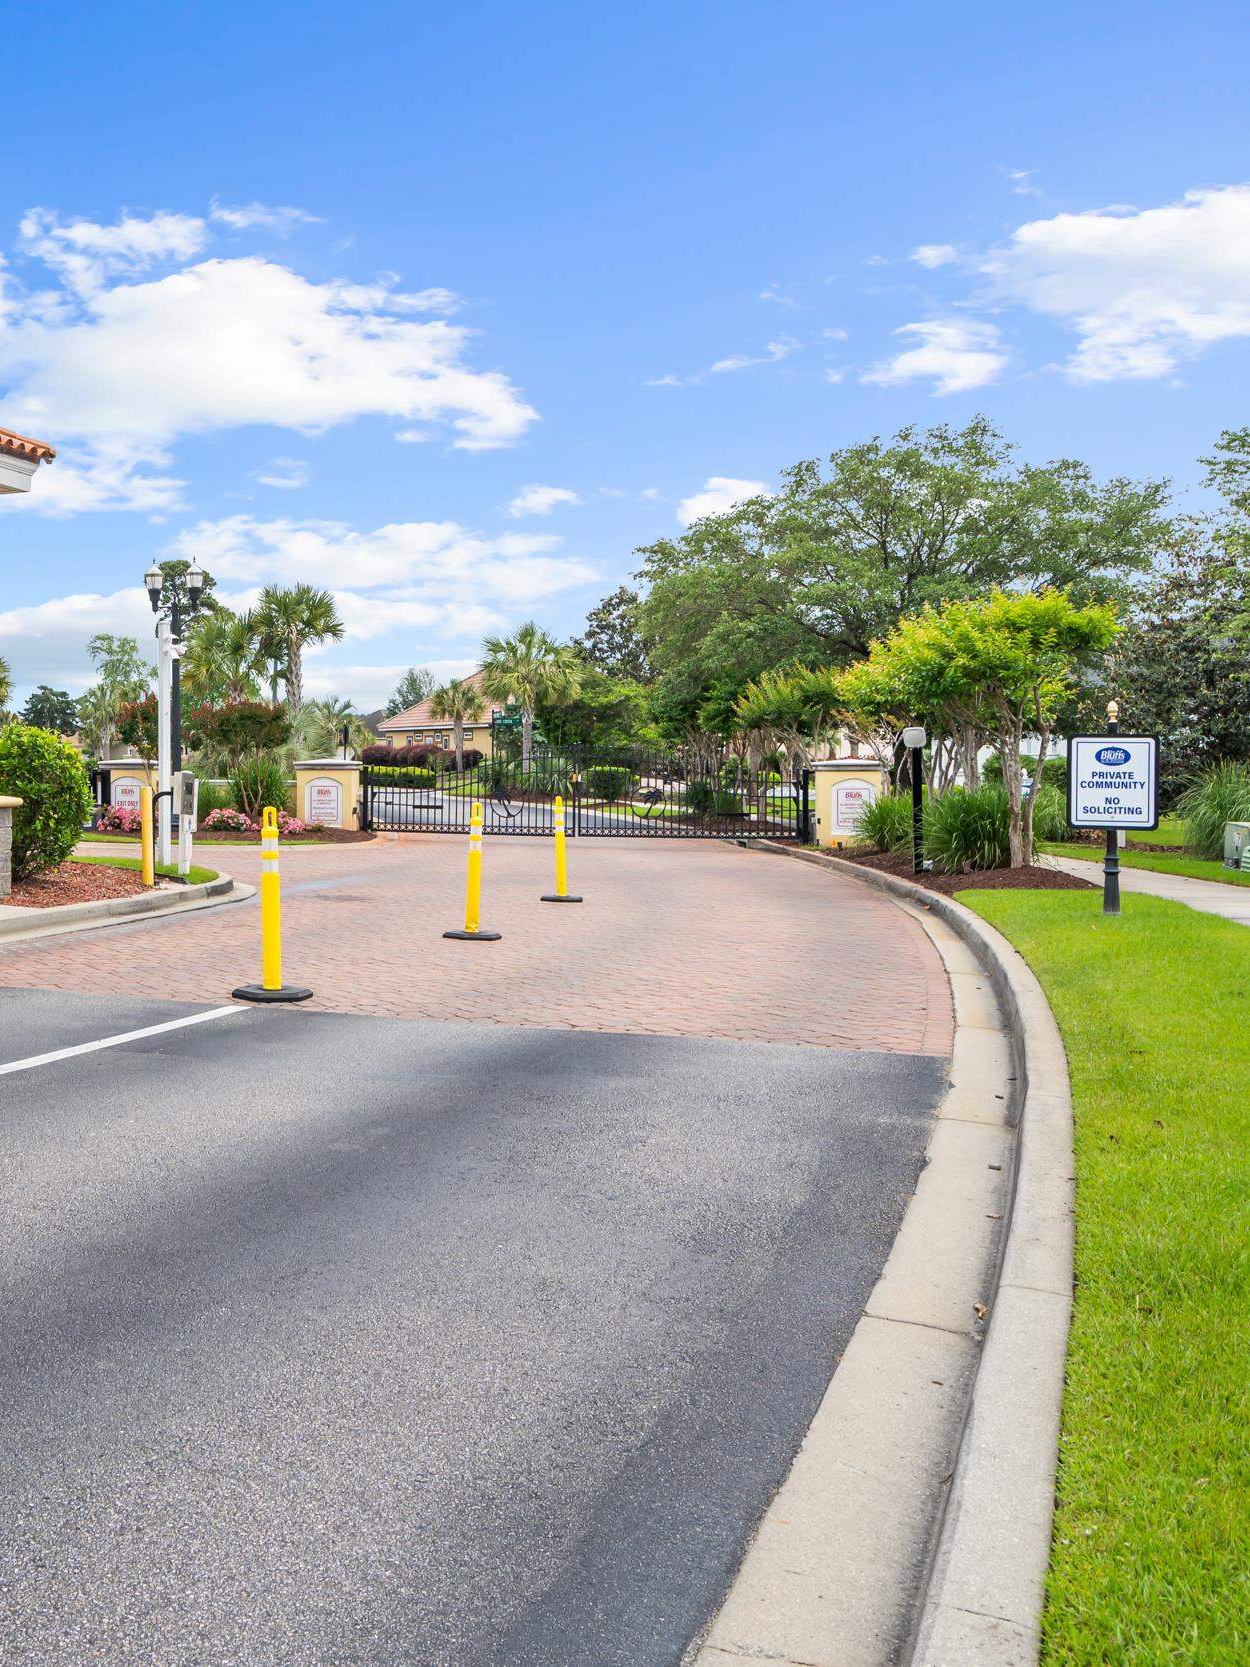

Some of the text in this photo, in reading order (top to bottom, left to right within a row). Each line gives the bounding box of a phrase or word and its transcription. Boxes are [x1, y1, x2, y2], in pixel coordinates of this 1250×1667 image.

[1100, 750, 1125, 760] Bluffs
[1091, 771, 1134, 780] PRIVATE
[1080, 780, 1146, 789] COMMUNITY
[1105, 797, 1120, 805] NO
[1082, 806, 1142, 815] SOLICITING
